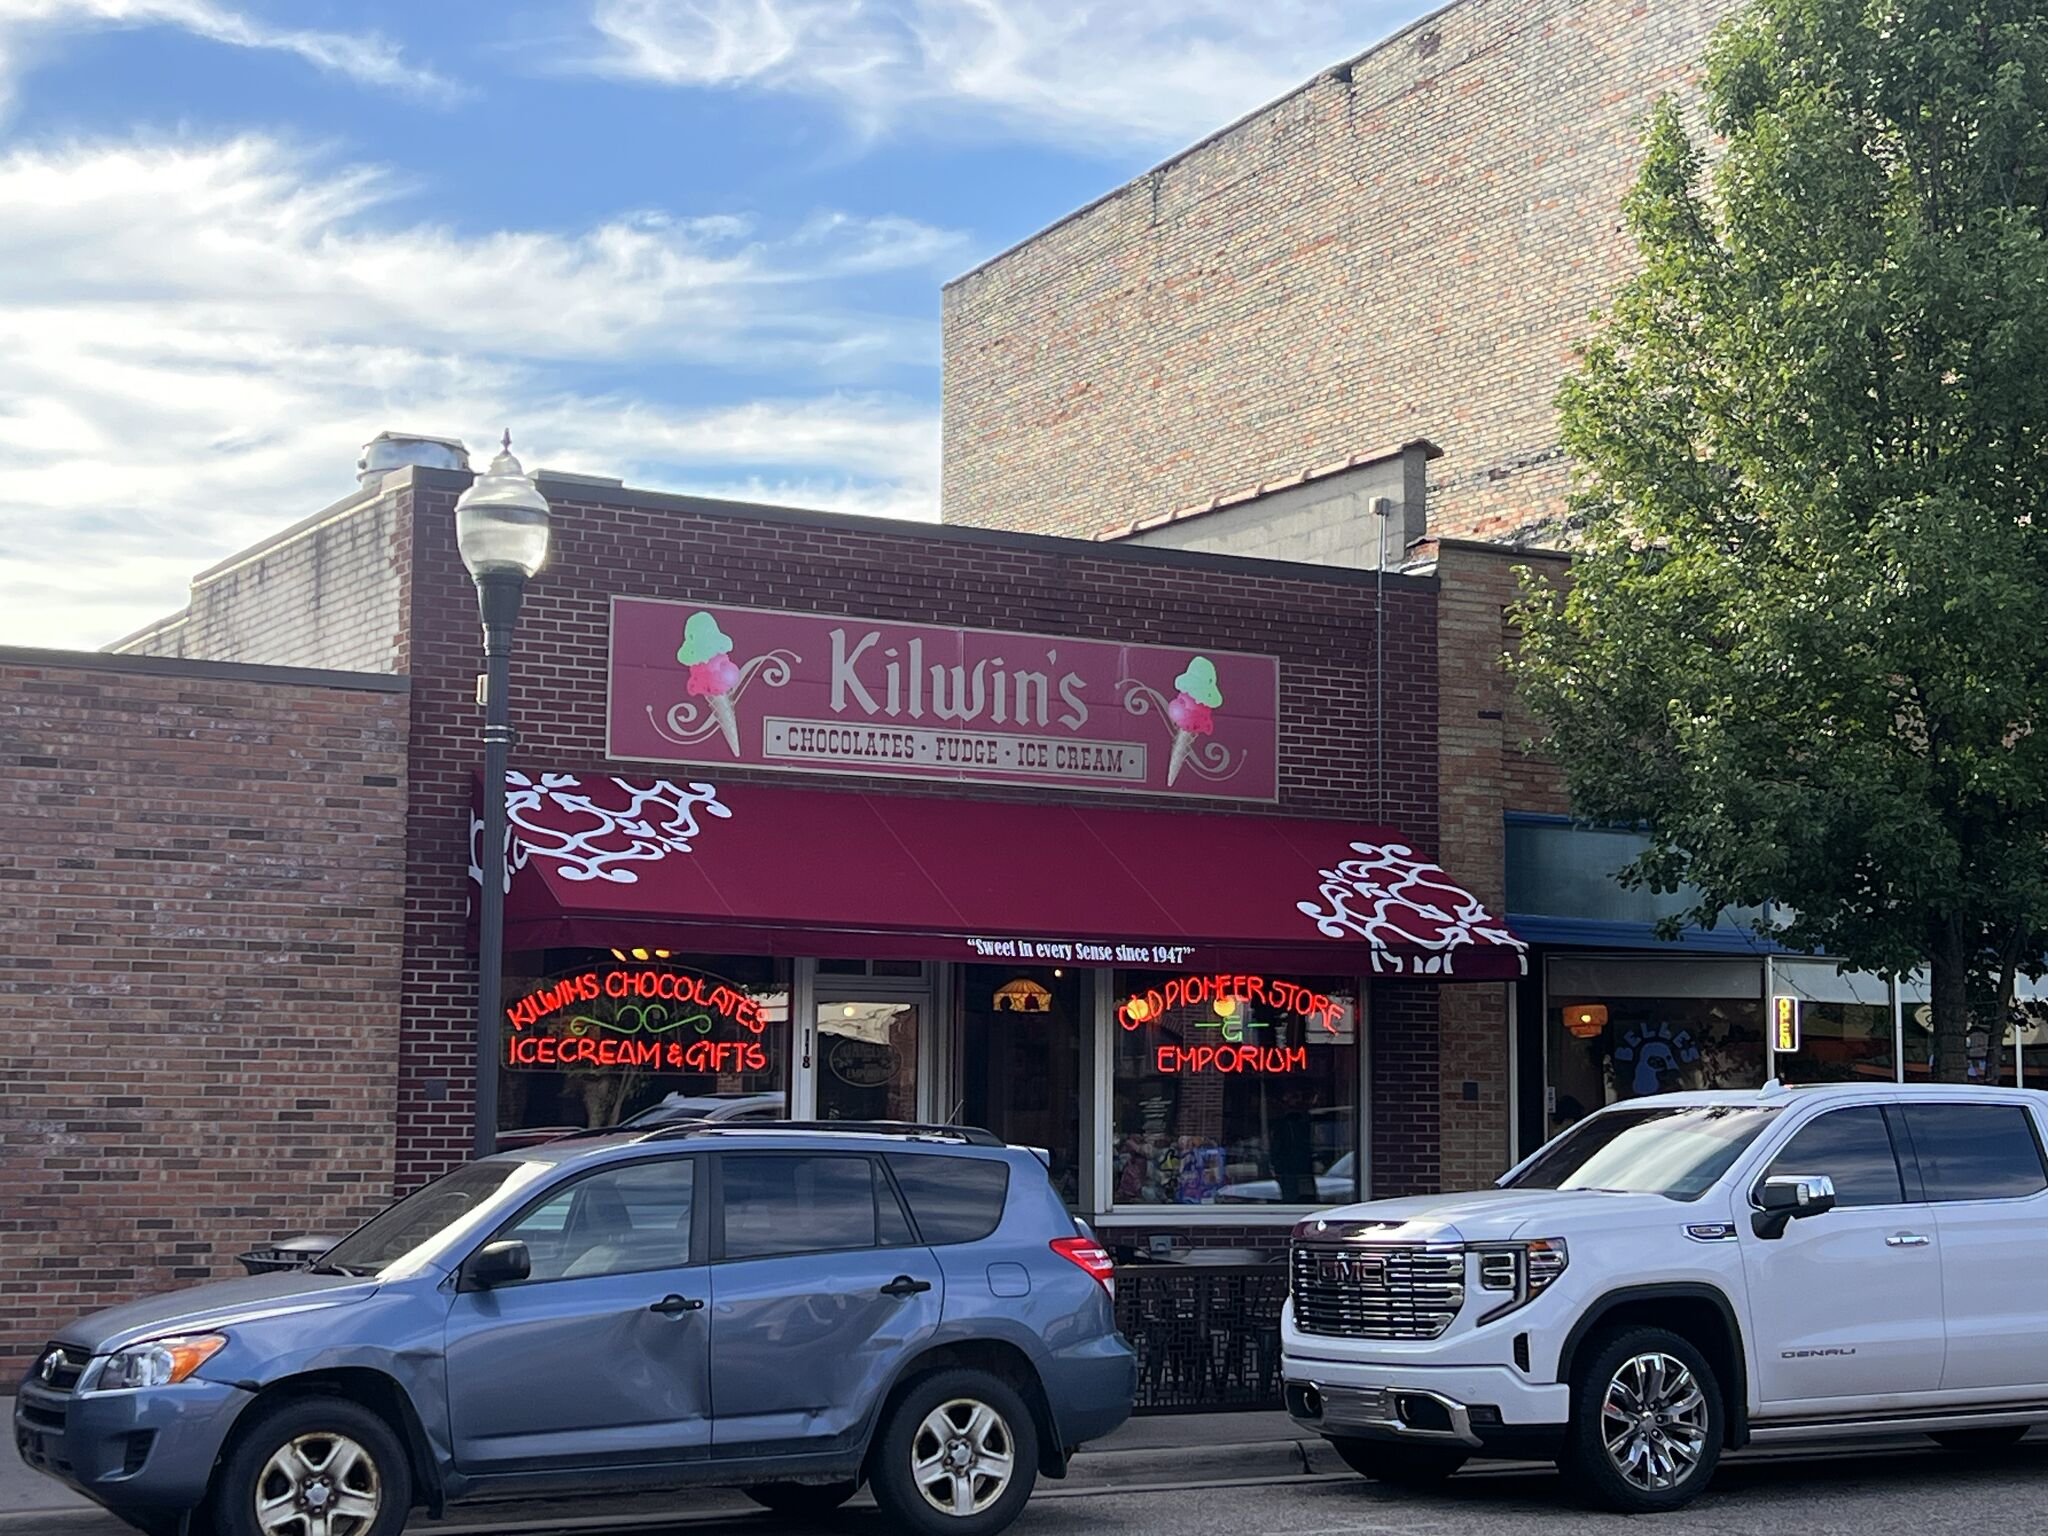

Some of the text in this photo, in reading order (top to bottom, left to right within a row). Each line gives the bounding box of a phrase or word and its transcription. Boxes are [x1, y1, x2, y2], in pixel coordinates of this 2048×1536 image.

[829, 628, 1089, 731] Kilwin's
[787, 726, 1123, 773] CHOCOLATES FUDGE ICE CREAM
[1018, 940, 1034, 958] in
[1036, 943, 1073, 961] every
[1075, 942, 1113, 962] Sense
[1116, 944, 1150, 963] since
[507, 972, 769, 1034] KILWINS CHOCOLATES
[1165, 975, 1266, 1010] PIONEER
[1268, 980, 1345, 1037] STORE
[1779, 997, 1791, 1049] OPEN
[802, 1028, 811, 1069] 118
[1156, 1045, 1307, 1073] EMPORIUM
[1320, 1261, 1382, 1282] GMC
[1781, 1348, 1856, 1358] DENALI
